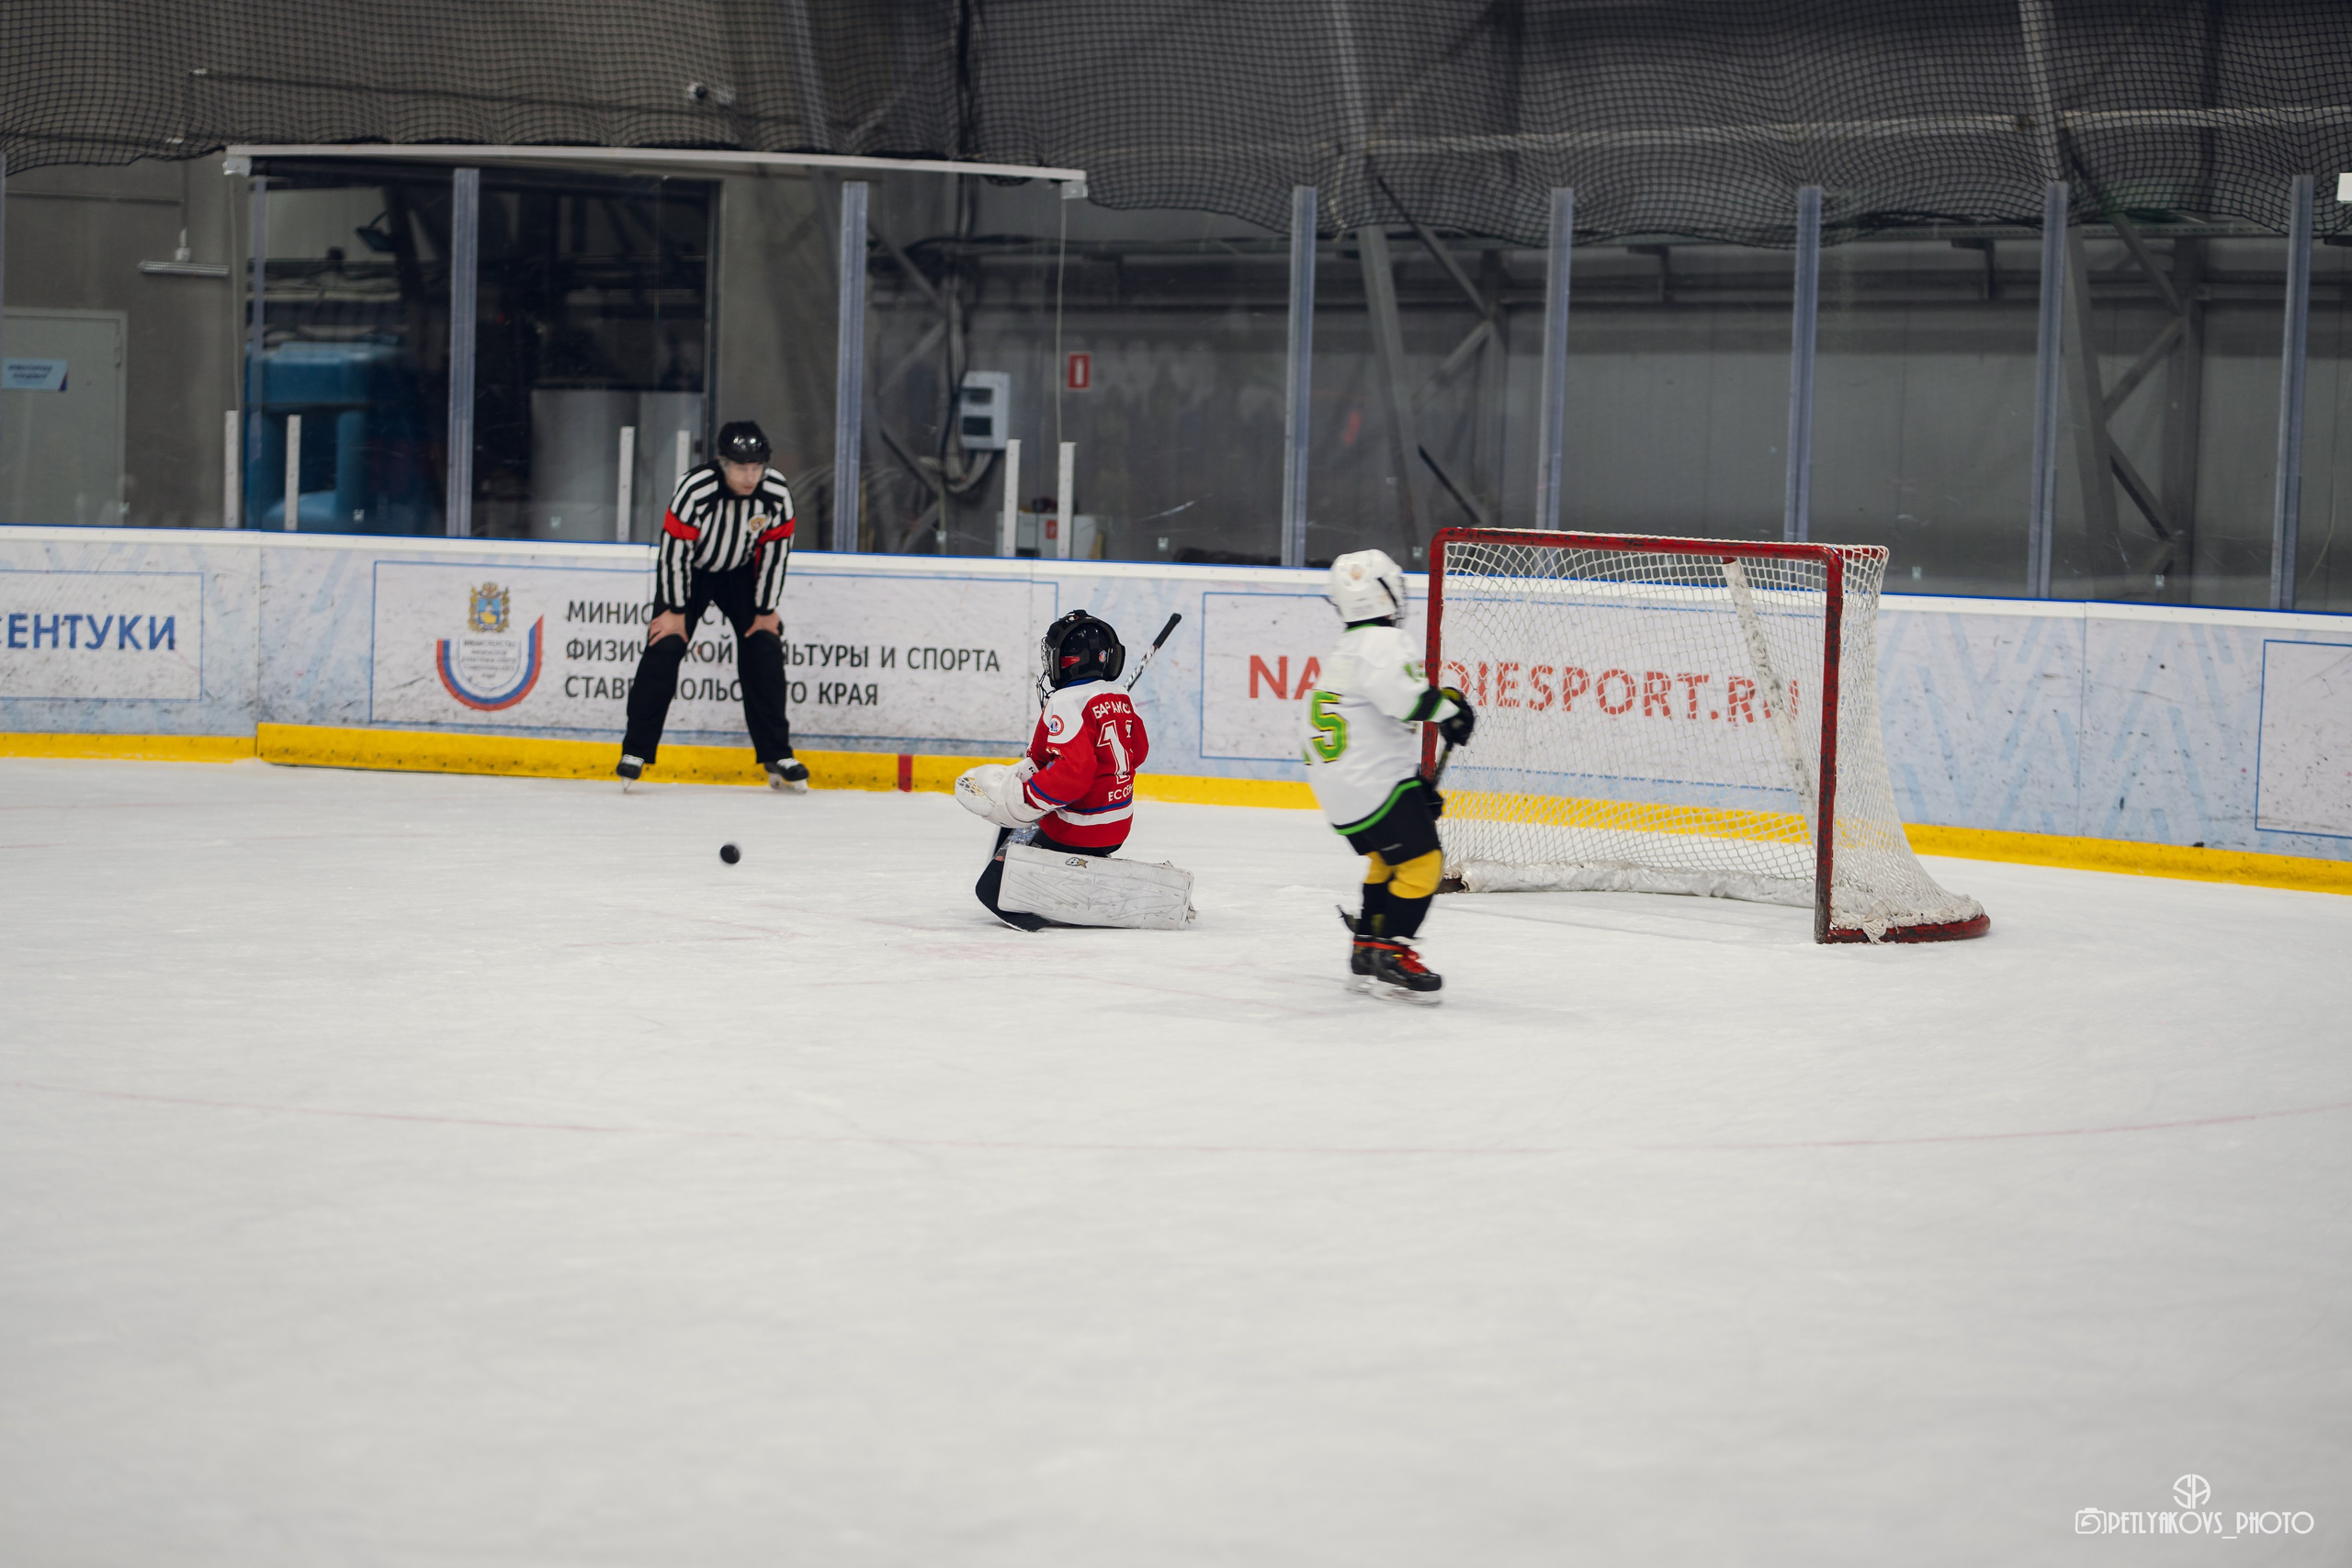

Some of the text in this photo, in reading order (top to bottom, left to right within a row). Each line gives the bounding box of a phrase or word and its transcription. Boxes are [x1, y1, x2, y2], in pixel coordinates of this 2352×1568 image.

[0, 613, 175, 650] ЕНТУКИ
[881, 646, 896, 669] И
[907, 648, 1001, 672] СПОРТА
[819, 682, 878, 705] КРАЯ
[1302, 689, 1348, 764] 5
